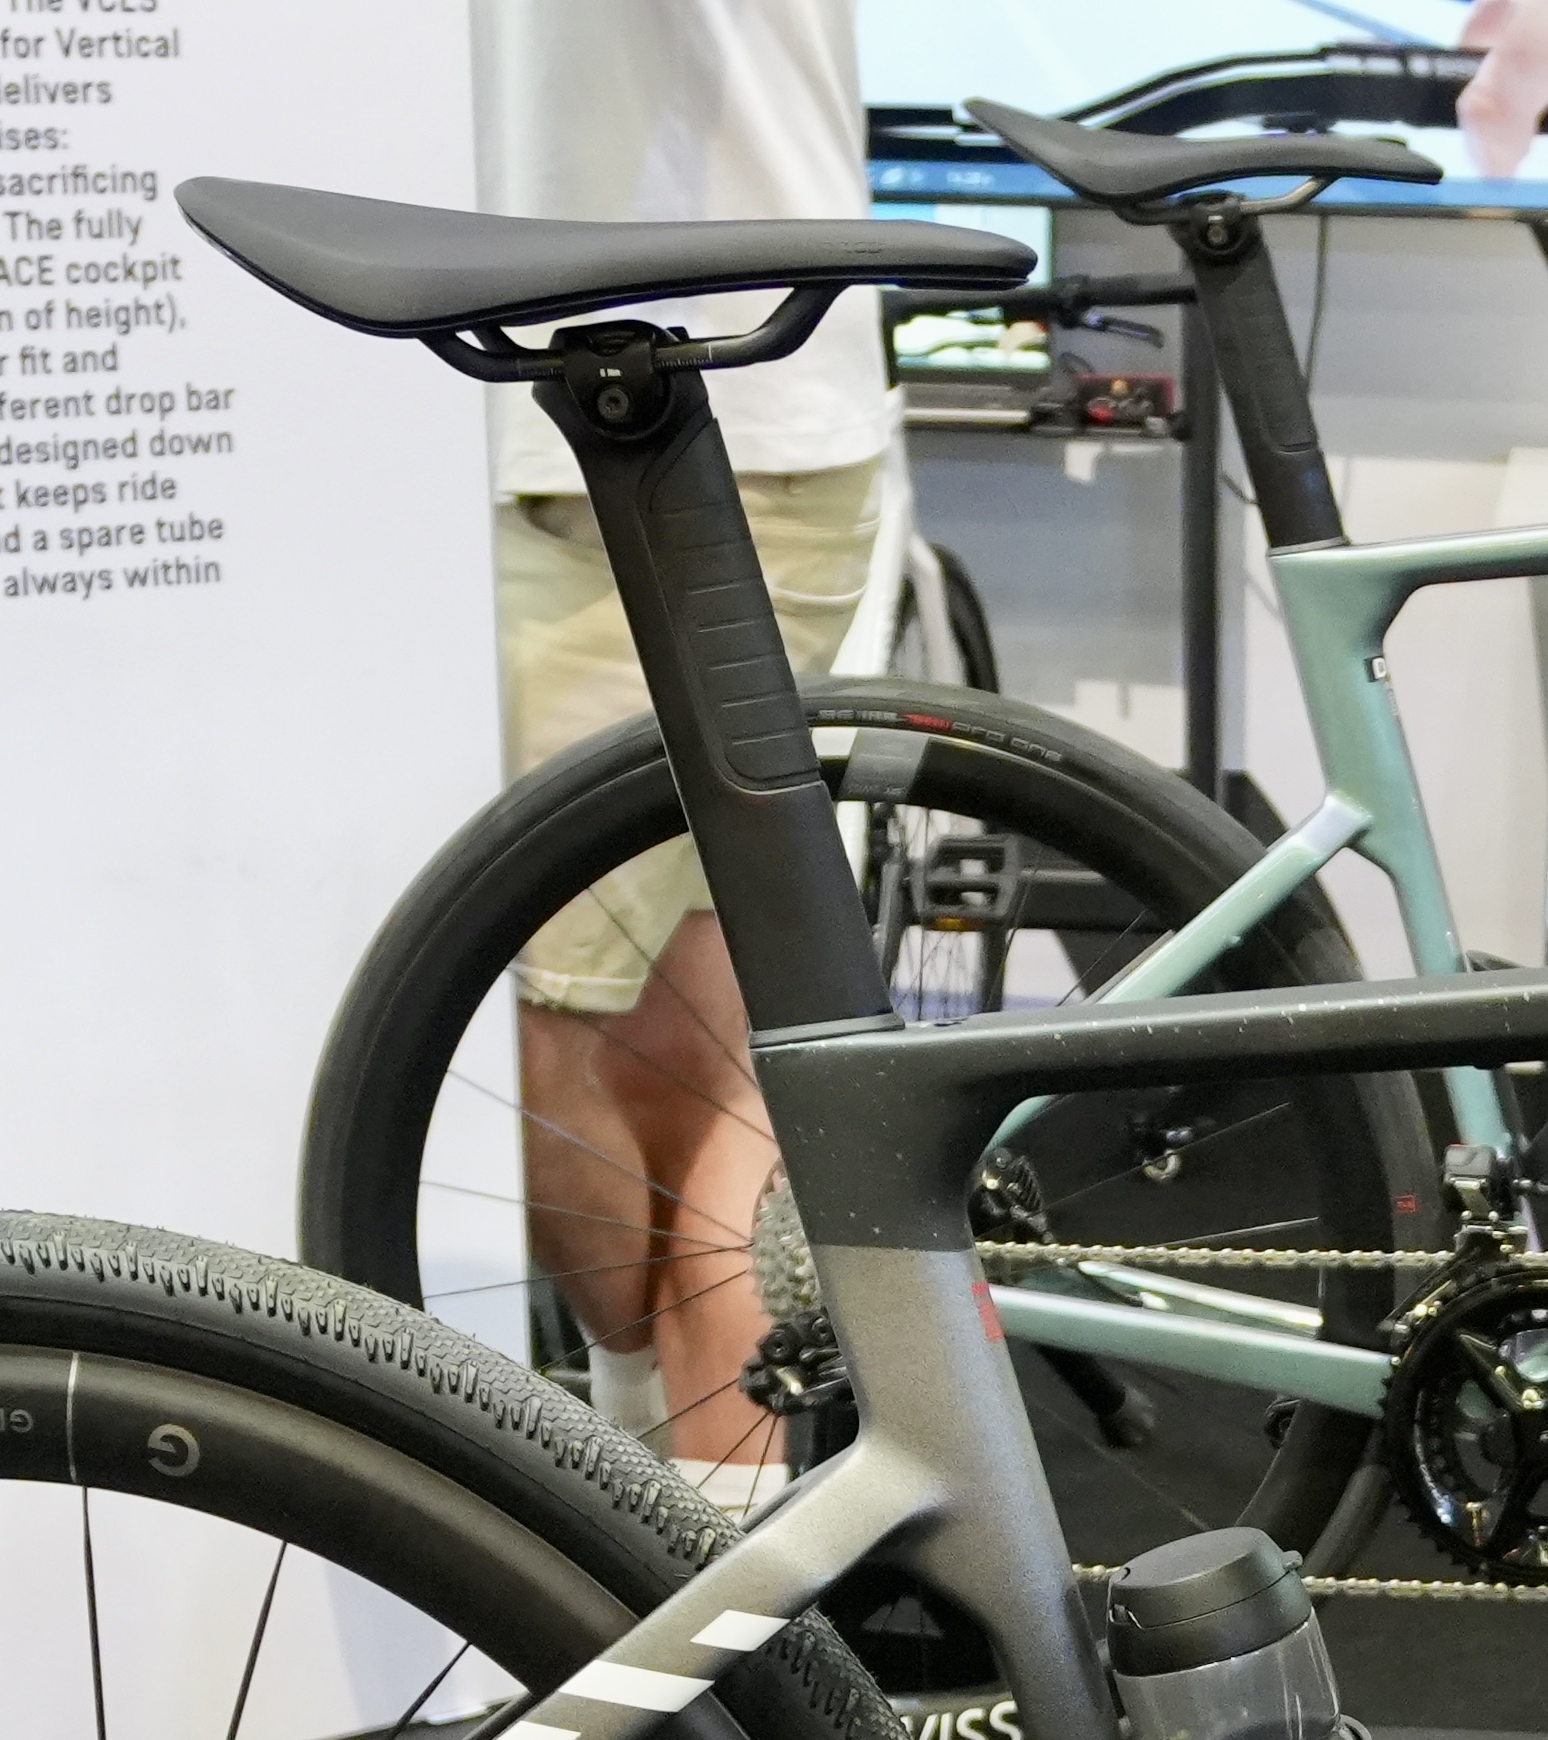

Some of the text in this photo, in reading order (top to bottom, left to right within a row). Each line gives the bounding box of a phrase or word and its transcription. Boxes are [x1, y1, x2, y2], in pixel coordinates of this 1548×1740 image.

[54, 27, 181, 59] Vertical
[2, 210, 64, 241] The
[72, 209, 143, 247] fully
[65, 252, 183, 291] cockpit
[24, 299, 56, 332] of
[18, 345, 53, 376] fit
[62, 342, 119, 374] and
[105, 386, 176, 422] drop
[185, 382, 236, 413] bar
[149, 428, 234, 458] down
[15, 479, 108, 514] keeps
[117, 471, 178, 503] ride
[32, 529, 50, 552] a
[59, 523, 146, 557] spare
[154, 512, 225, 544] tube
[3, 567, 114, 601] always
[122, 556, 222, 589] within
